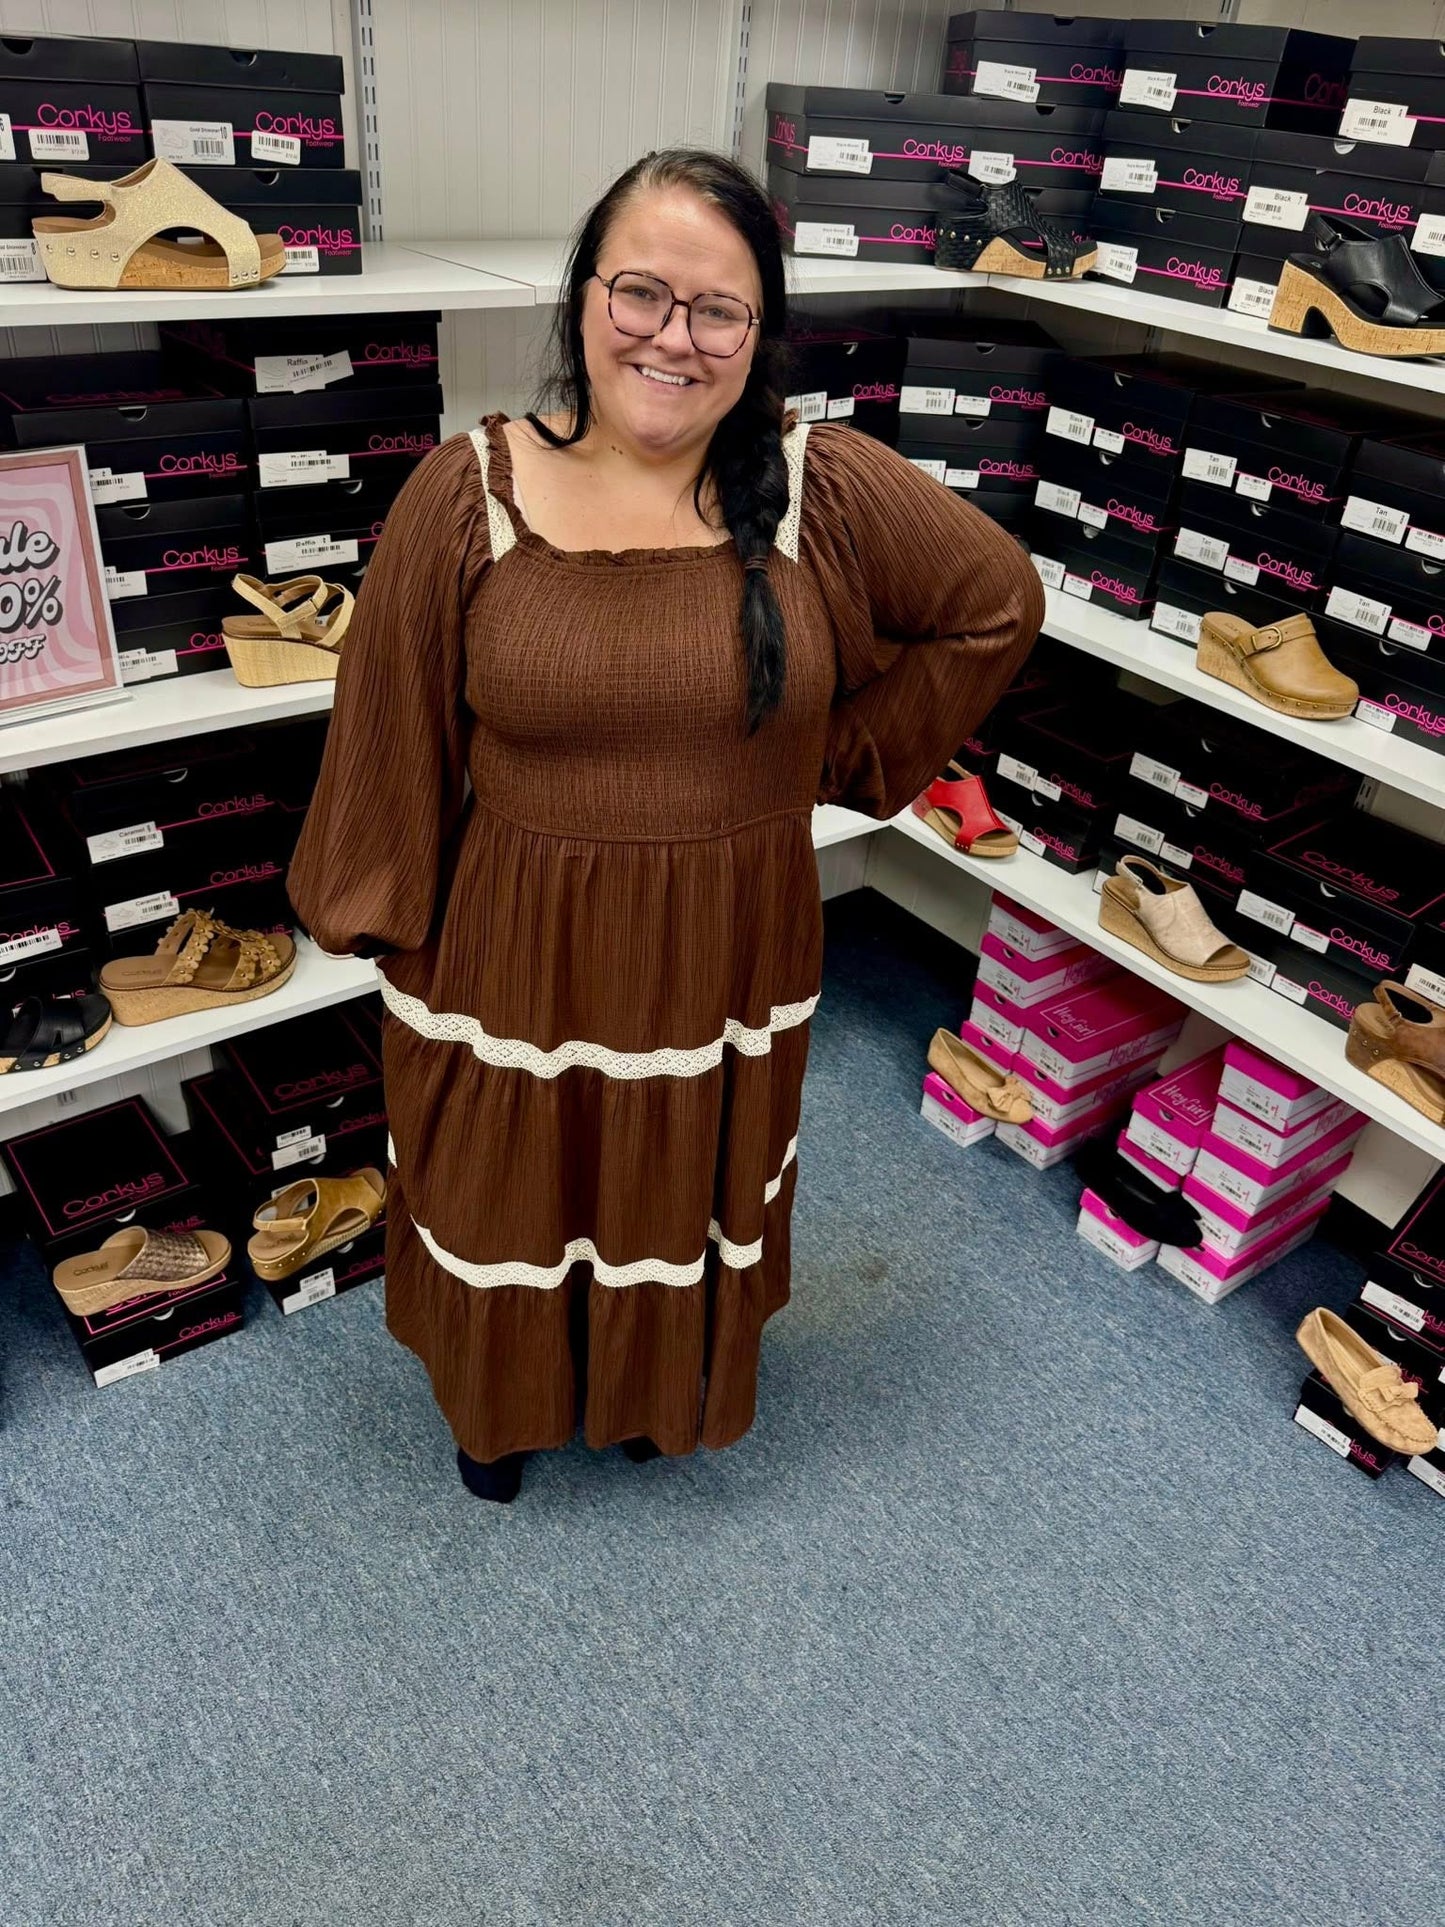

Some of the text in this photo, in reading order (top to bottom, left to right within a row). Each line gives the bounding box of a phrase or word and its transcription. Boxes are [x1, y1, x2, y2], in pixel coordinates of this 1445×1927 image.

[1070, 63, 1122, 86] Corky
[1207, 74, 1266, 100] Corkys
[37, 104, 132, 135] Corkys
[1373, 105, 1392, 116] Black
[255, 111, 335, 140] Corkys
[903, 139, 965, 162] Corkys
[1051, 147, 1101, 170] Corky
[1183, 168, 1240, 195] Corkys
[1274, 193, 1292, 203] Black
[1344, 193, 1411, 224] Corkys
[277, 225, 353, 250] Corkys
[1166, 256, 1222, 285] Corkys
[1258, 285, 1275, 296] Black
[364, 341, 431, 363] Corkys
[852, 380, 895, 399] Corkys
[989, 386, 1046, 406] Corkys
[368, 431, 434, 453] Corkys
[1122, 422, 1172, 449] Corkys
[159, 451, 237, 473] Corkys
[978, 458, 1034, 478] Corkys
[1209, 455, 1220, 464] Tan
[1268, 466, 1325, 498] Corkys
[1107, 498, 1154, 527] Corkys
[1375, 506, 1388, 517] Tan
[163, 545, 239, 567] Corkys
[1257, 552, 1313, 585] Corkys
[1091, 570, 1137, 600] Corkys
[0, 575, 63, 634] 0%
[1358, 598, 1370, 607] Tan
[1385, 693, 1445, 729] Corkys
[198, 793, 268, 818] Corkys
[1210, 782, 1264, 815] Corkys
[1033, 826, 1075, 857] Corkys
[209, 860, 276, 885] Corkys
[1302, 851, 1400, 901] Corkys
[1330, 927, 1391, 966] Corkys
[1308, 981, 1355, 1017] Corky
[273, 1063, 369, 1099] Corkys
[62, 1172, 166, 1216] Corkys
[179, 1311, 237, 1339] Corkys
